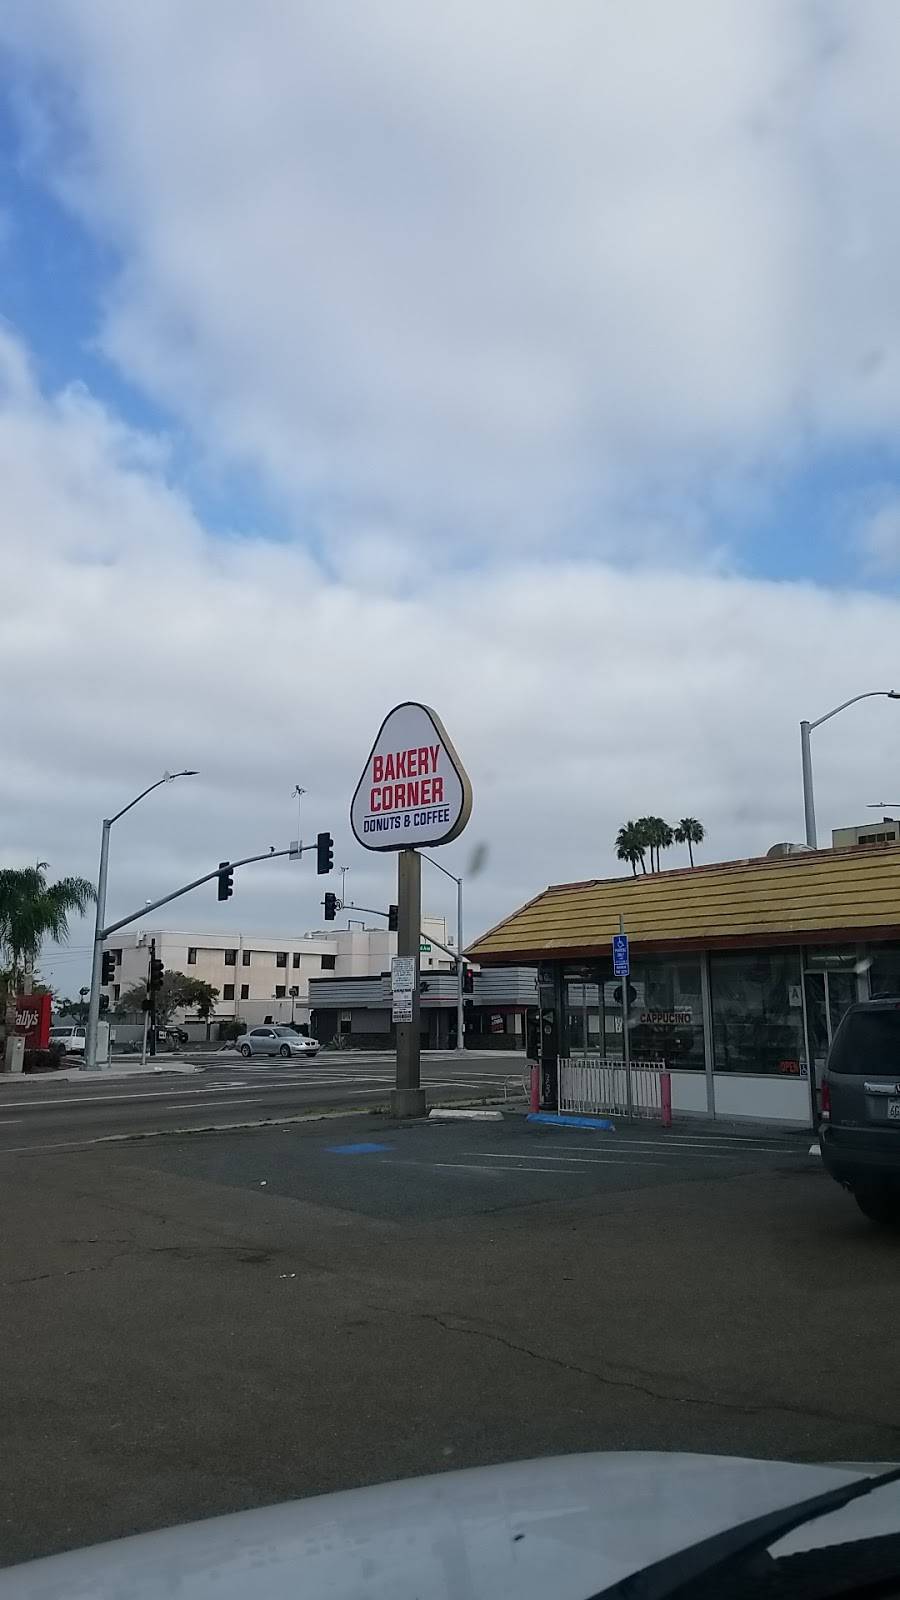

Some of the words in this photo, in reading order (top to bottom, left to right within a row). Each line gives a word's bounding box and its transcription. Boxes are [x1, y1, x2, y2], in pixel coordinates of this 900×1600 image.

[372, 744, 440, 783] BAKERY
[370, 777, 444, 812] CORNER
[363, 816, 401, 833] DONUTS
[404, 814, 411, 828] &
[413, 808, 450, 827] COFFEE
[640, 1013, 691, 1024] CAPPUCINO
[779, 1060, 799, 1073] OPEN
